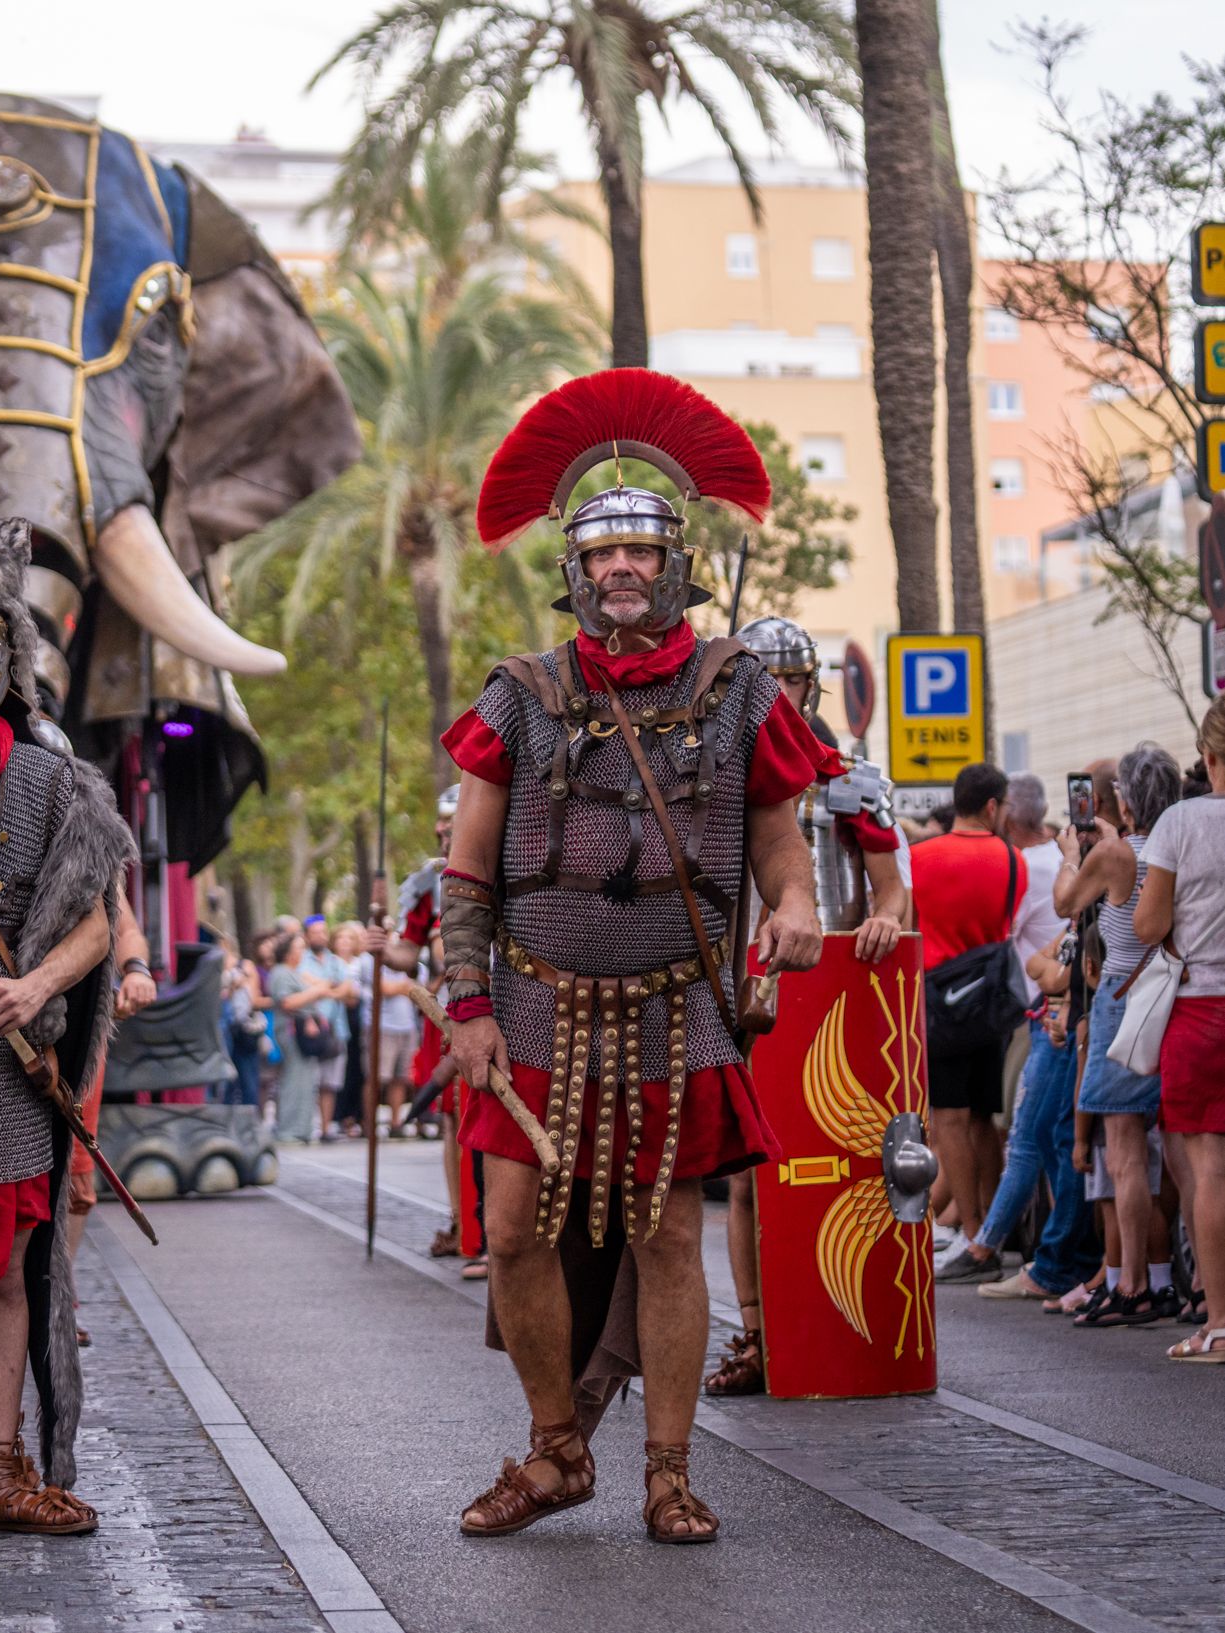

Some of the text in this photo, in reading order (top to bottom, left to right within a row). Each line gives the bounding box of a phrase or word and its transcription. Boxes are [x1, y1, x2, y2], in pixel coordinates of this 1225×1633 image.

[1207, 247, 1225, 269] P
[915, 656, 957, 711] P
[904, 727, 971, 744] TENIS
